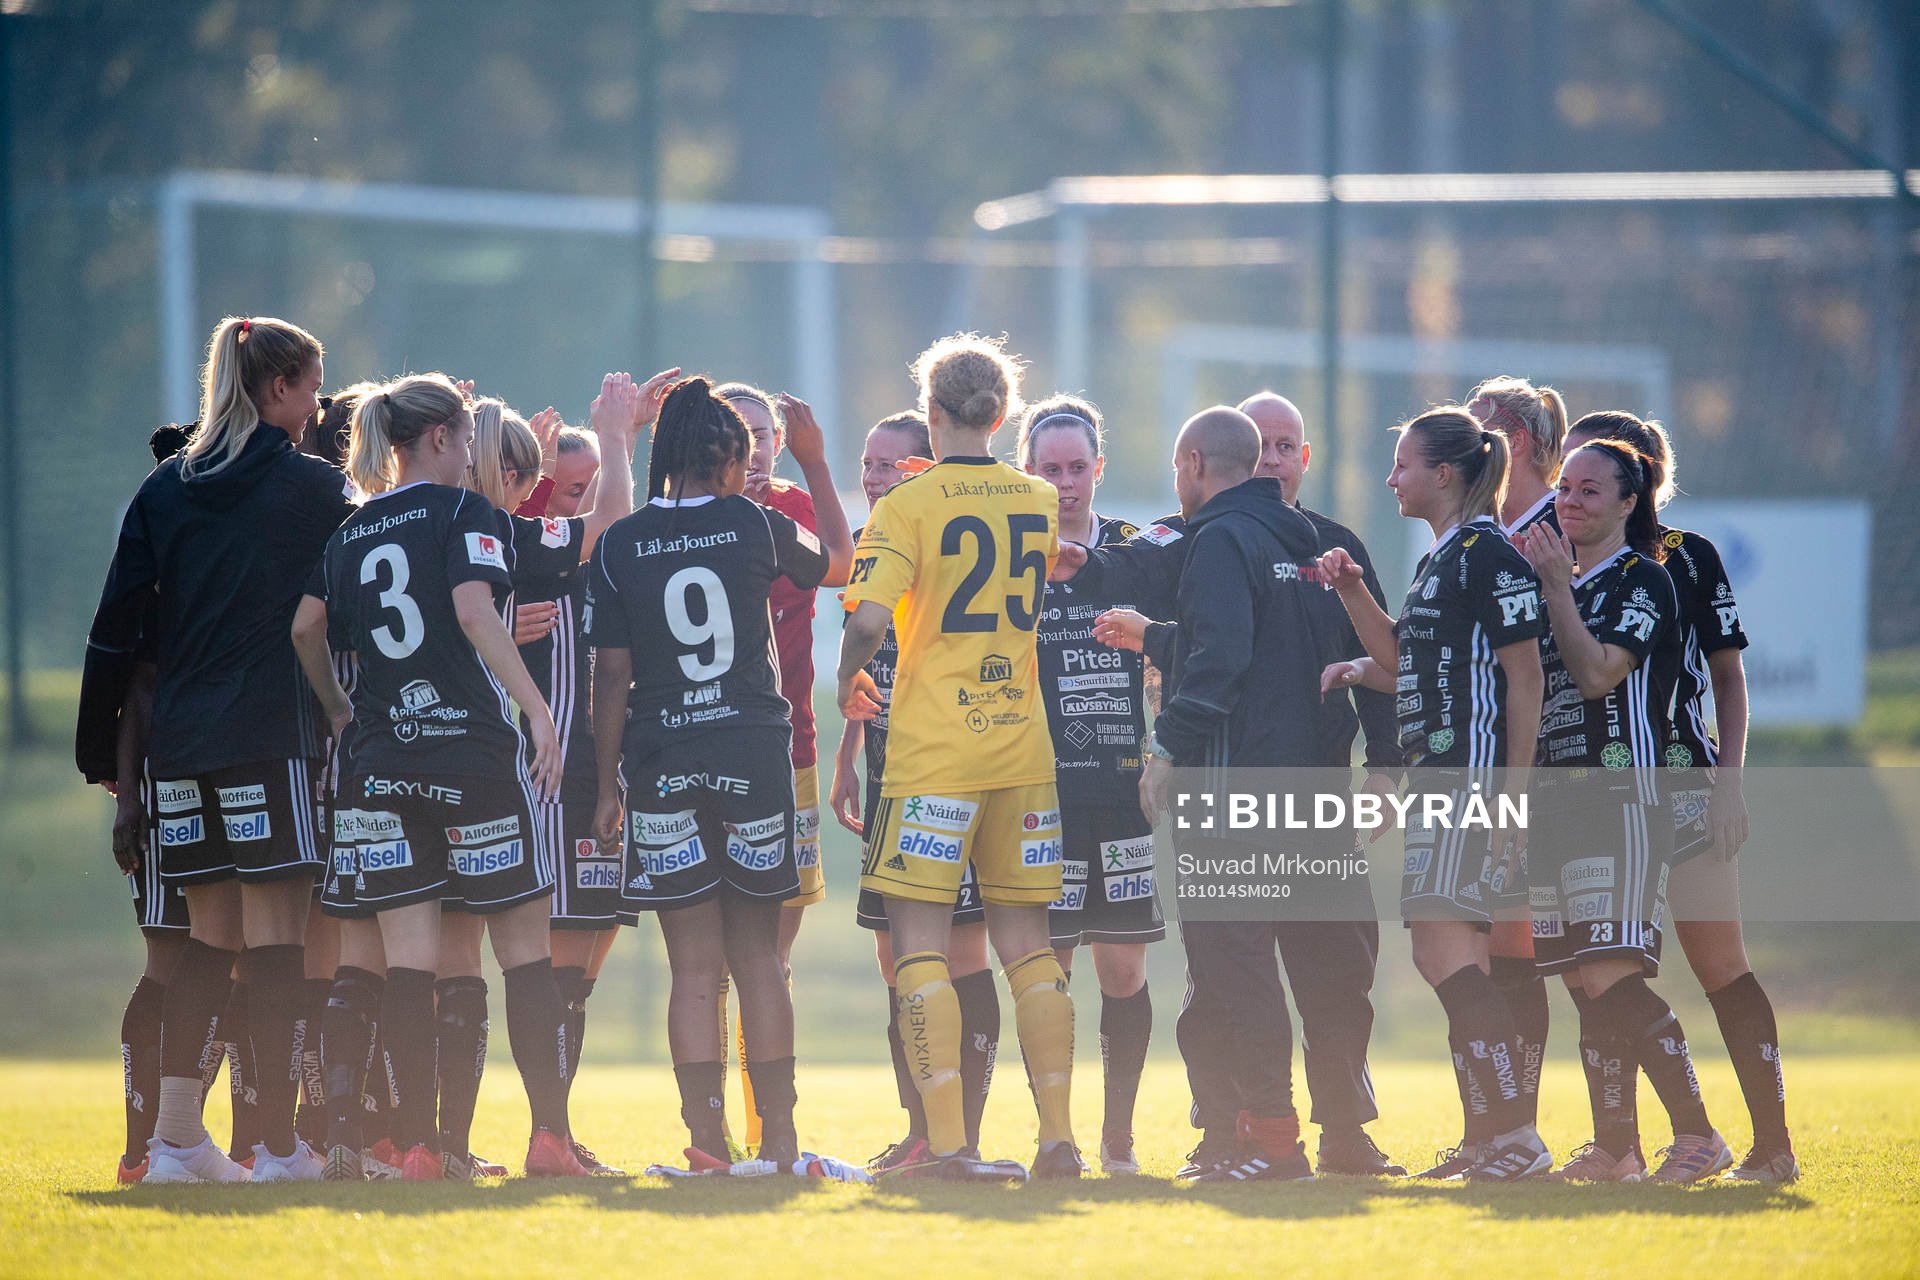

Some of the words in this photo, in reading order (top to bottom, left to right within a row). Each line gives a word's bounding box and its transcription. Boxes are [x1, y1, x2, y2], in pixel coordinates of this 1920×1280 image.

[941, 481, 1032, 499] LäkarJouren
[342, 507, 427, 546] LäkarJouren
[635, 531, 738, 558] LäkarJouren
[849, 556, 879, 585] PT
[940, 514, 1048, 634] 25
[360, 543, 425, 660] 3
[1497, 590, 1538, 627] PT
[663, 566, 735, 682] 9
[1036, 626, 1095, 645] Sparbank
[1613, 608, 1655, 642] PT
[871, 659, 898, 684] Pite
[1074, 677, 1107, 687] Smurfit
[158, 788, 197, 803] äiden
[374, 779, 463, 806] SKYLITE
[668, 772, 750, 796] SKYLITE
[160, 817, 200, 844] lsell
[225, 814, 266, 839] hlsell
[464, 821, 518, 841] AllOffice
[740, 819, 784, 838] AllOffice
[457, 842, 520, 873] ahlsell
[729, 841, 783, 869] ahlsell
[1025, 842, 1062, 865] ahls
[580, 864, 619, 886] ahlse
[1062, 865, 1088, 875] Office
[1108, 875, 1153, 900] ahls
[1532, 914, 1559, 935] sell
[1590, 922, 1614, 943] 23
[289, 1019, 306, 1081] WIXNERS
[908, 993, 934, 1081] WIXNERS
[303, 1050, 325, 1107] WIXNERS
[1489, 1042, 1518, 1100] WIXNERS
[1522, 1044, 1541, 1094] WIXNERS
